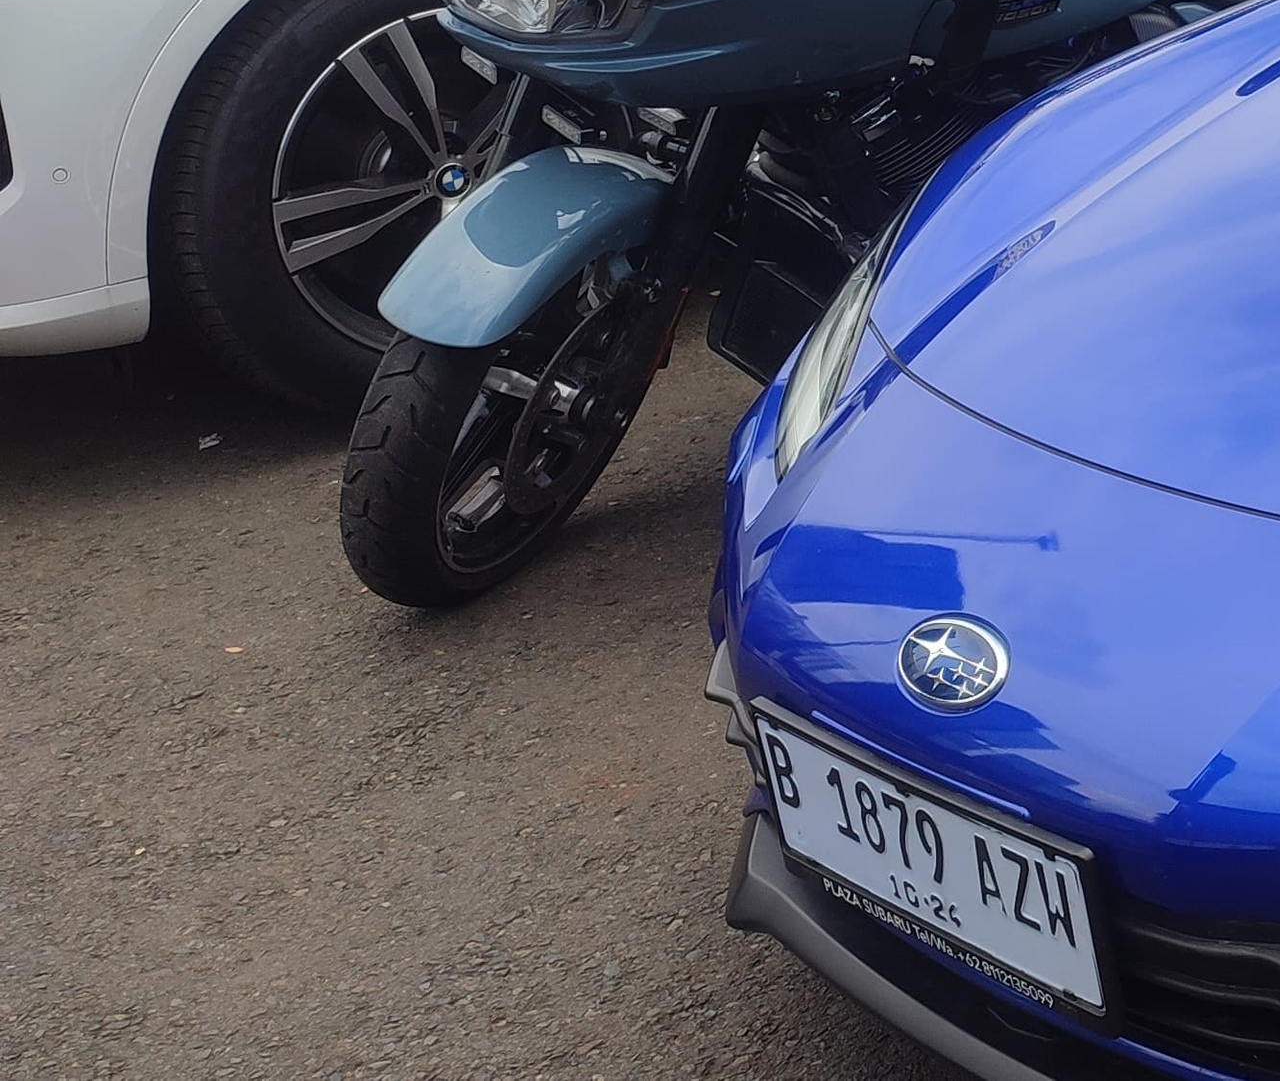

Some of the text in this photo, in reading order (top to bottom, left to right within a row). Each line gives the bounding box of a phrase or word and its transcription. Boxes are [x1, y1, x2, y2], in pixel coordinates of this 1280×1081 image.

[766, 730, 1078, 949] B 1879 AZW
[822, 877, 862, 910] PLAZA
[862, 898, 912, 935] SUBARU
